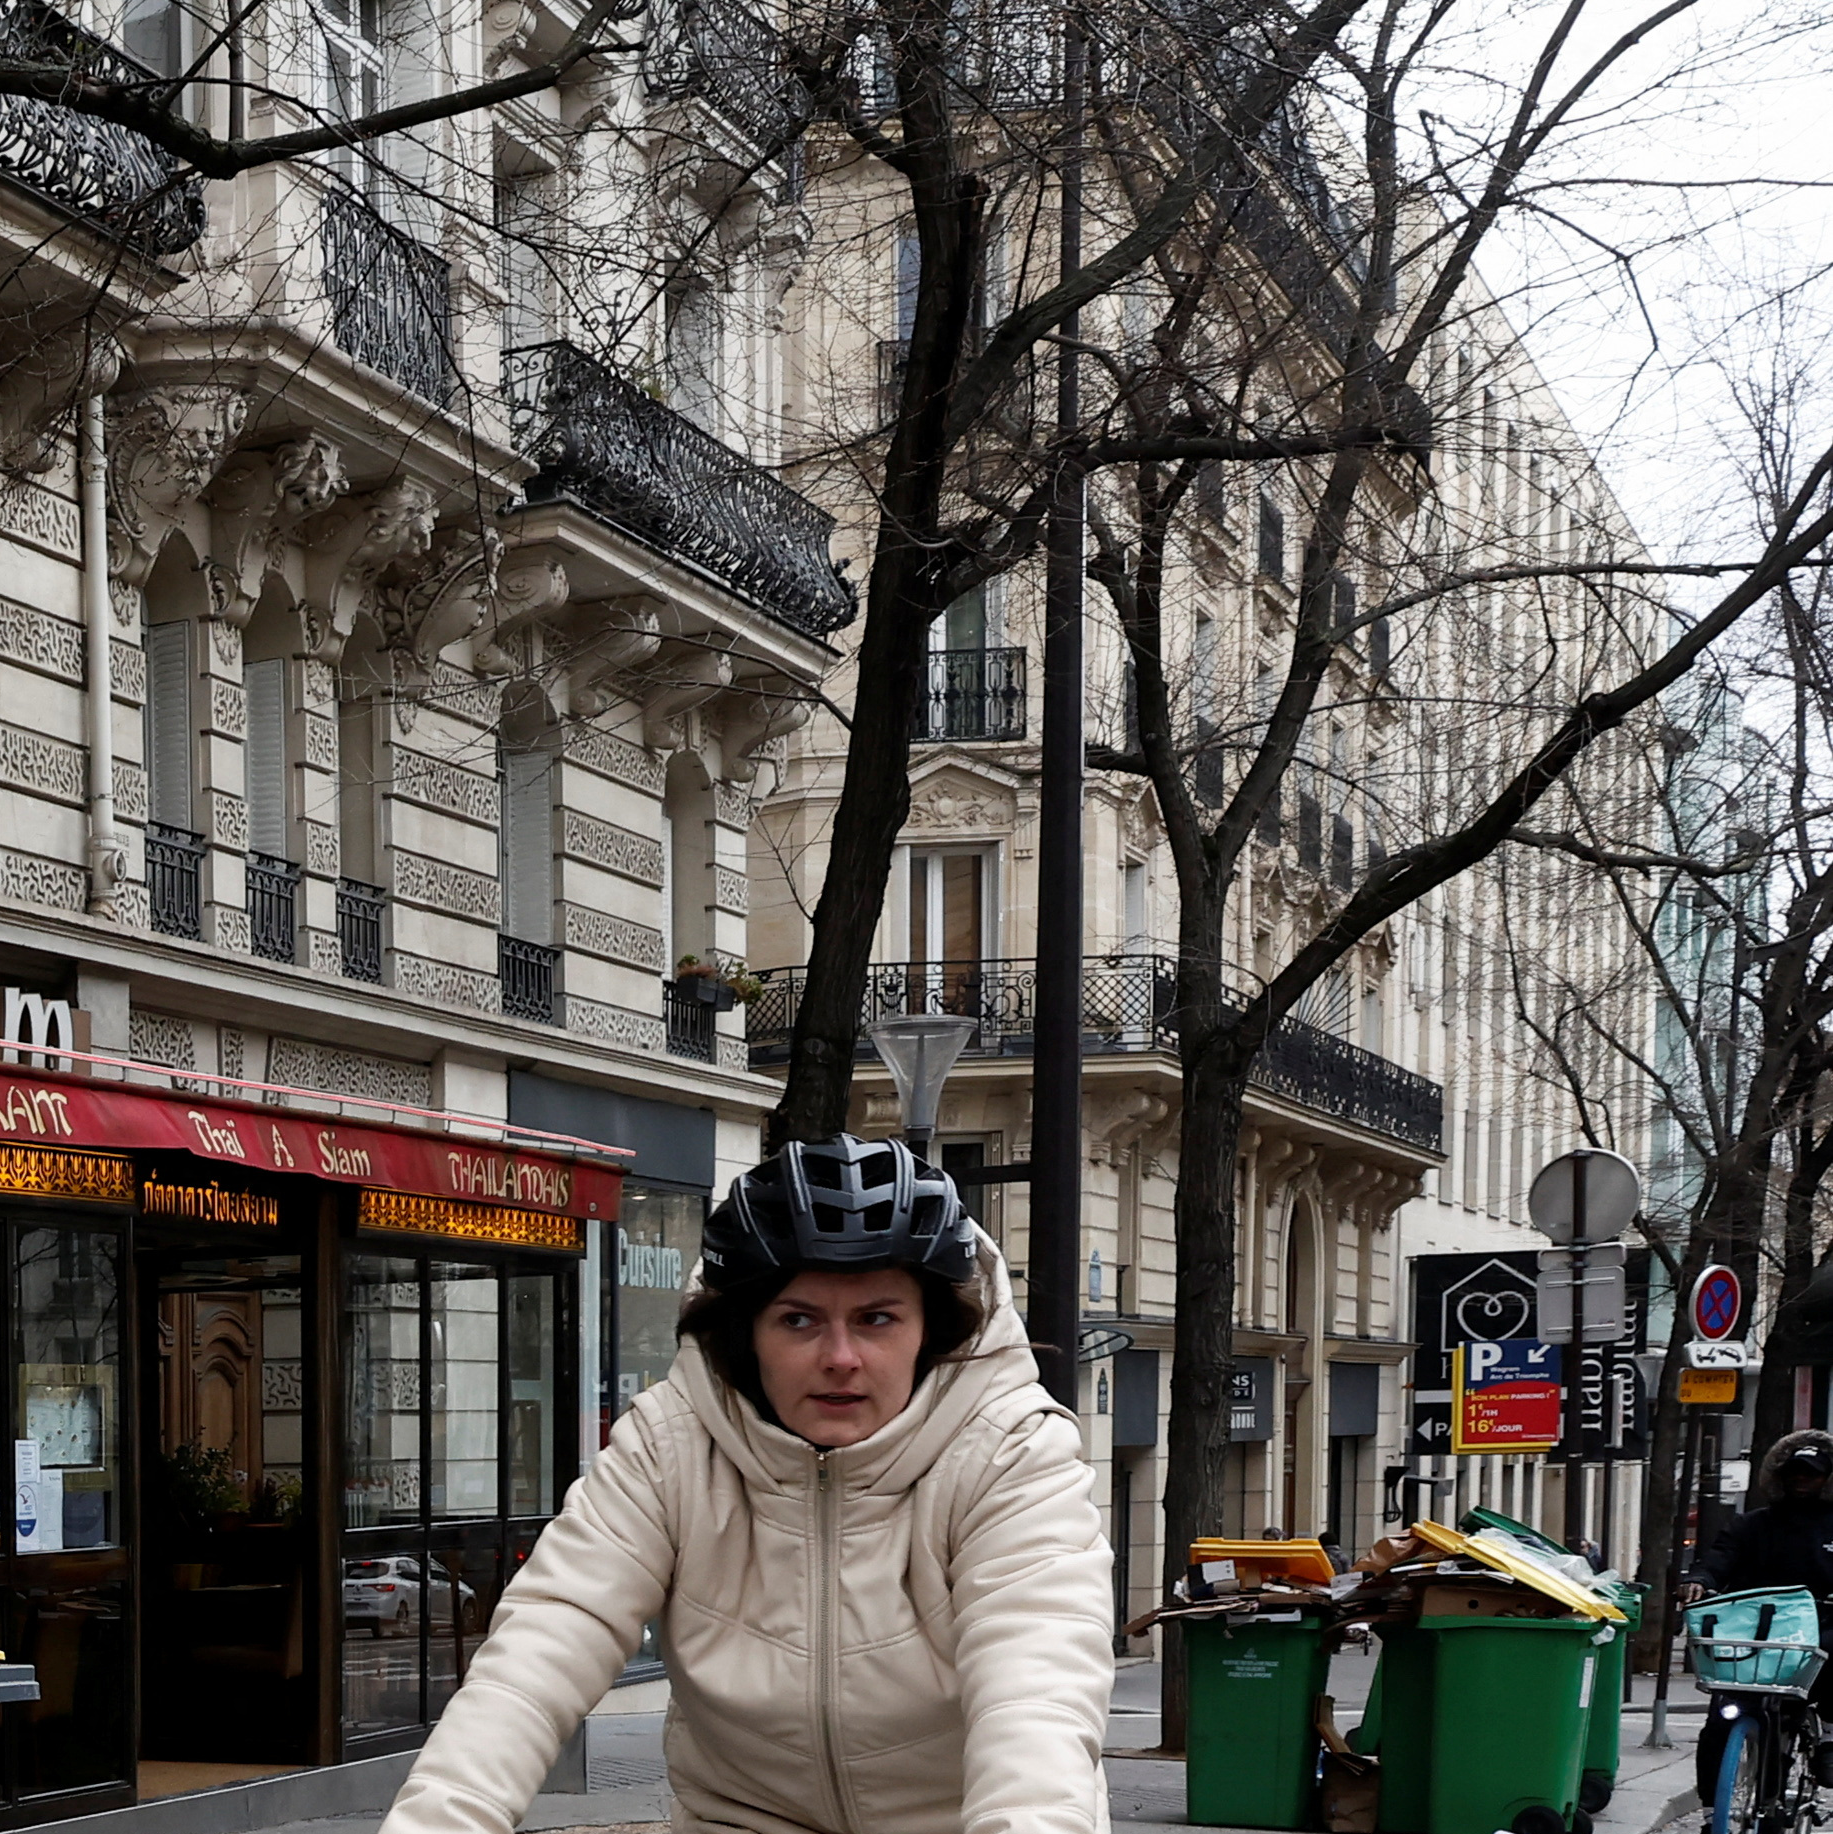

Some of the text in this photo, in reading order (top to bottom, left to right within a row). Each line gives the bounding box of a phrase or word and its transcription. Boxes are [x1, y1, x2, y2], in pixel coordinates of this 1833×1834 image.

[188, 1111, 245, 1159] Thaï
[320, 1131, 372, 1177] Siam
[447, 1151, 571, 1208] THAILANDAIS
[618, 1227, 682, 1290] Cuisine
[1471, 1343, 1502, 1380] P
